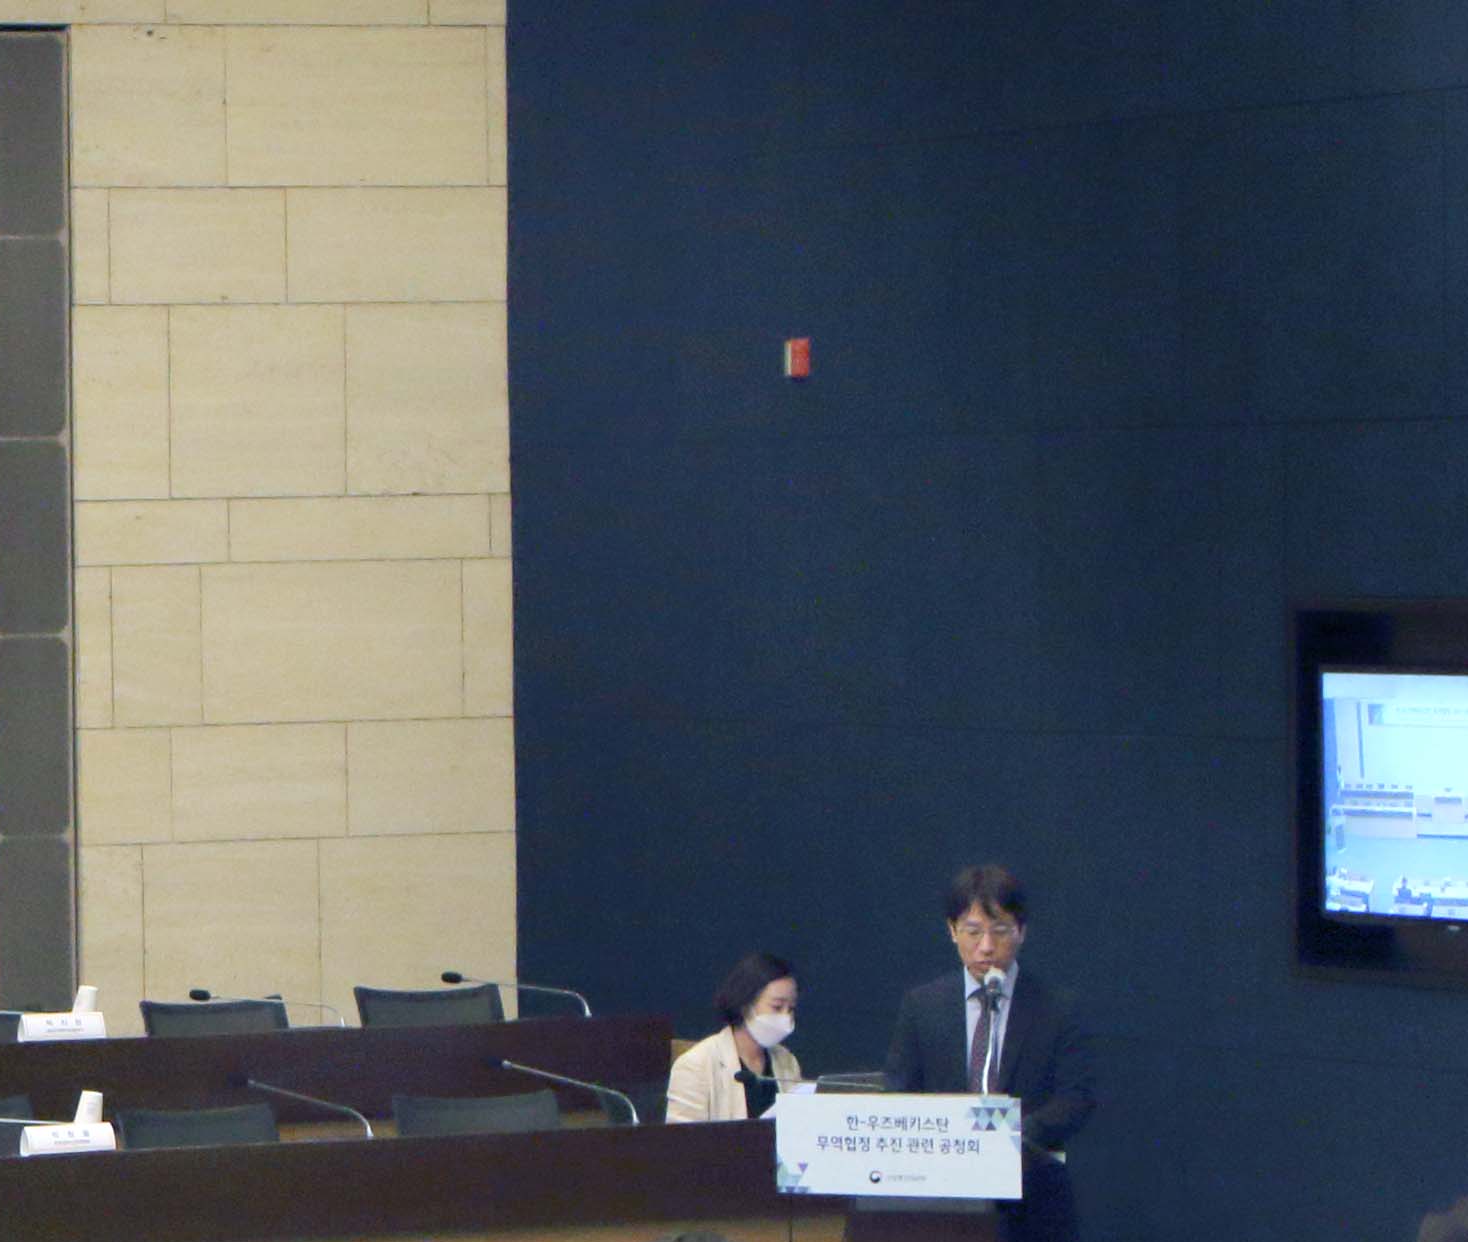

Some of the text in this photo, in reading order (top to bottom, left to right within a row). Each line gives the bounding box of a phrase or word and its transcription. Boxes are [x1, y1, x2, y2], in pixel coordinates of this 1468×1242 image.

[845, 1114, 950, 1134] 한-우즈베키스탄
[816, 1135, 981, 1155] 무역협정 추진 관련 공청회
